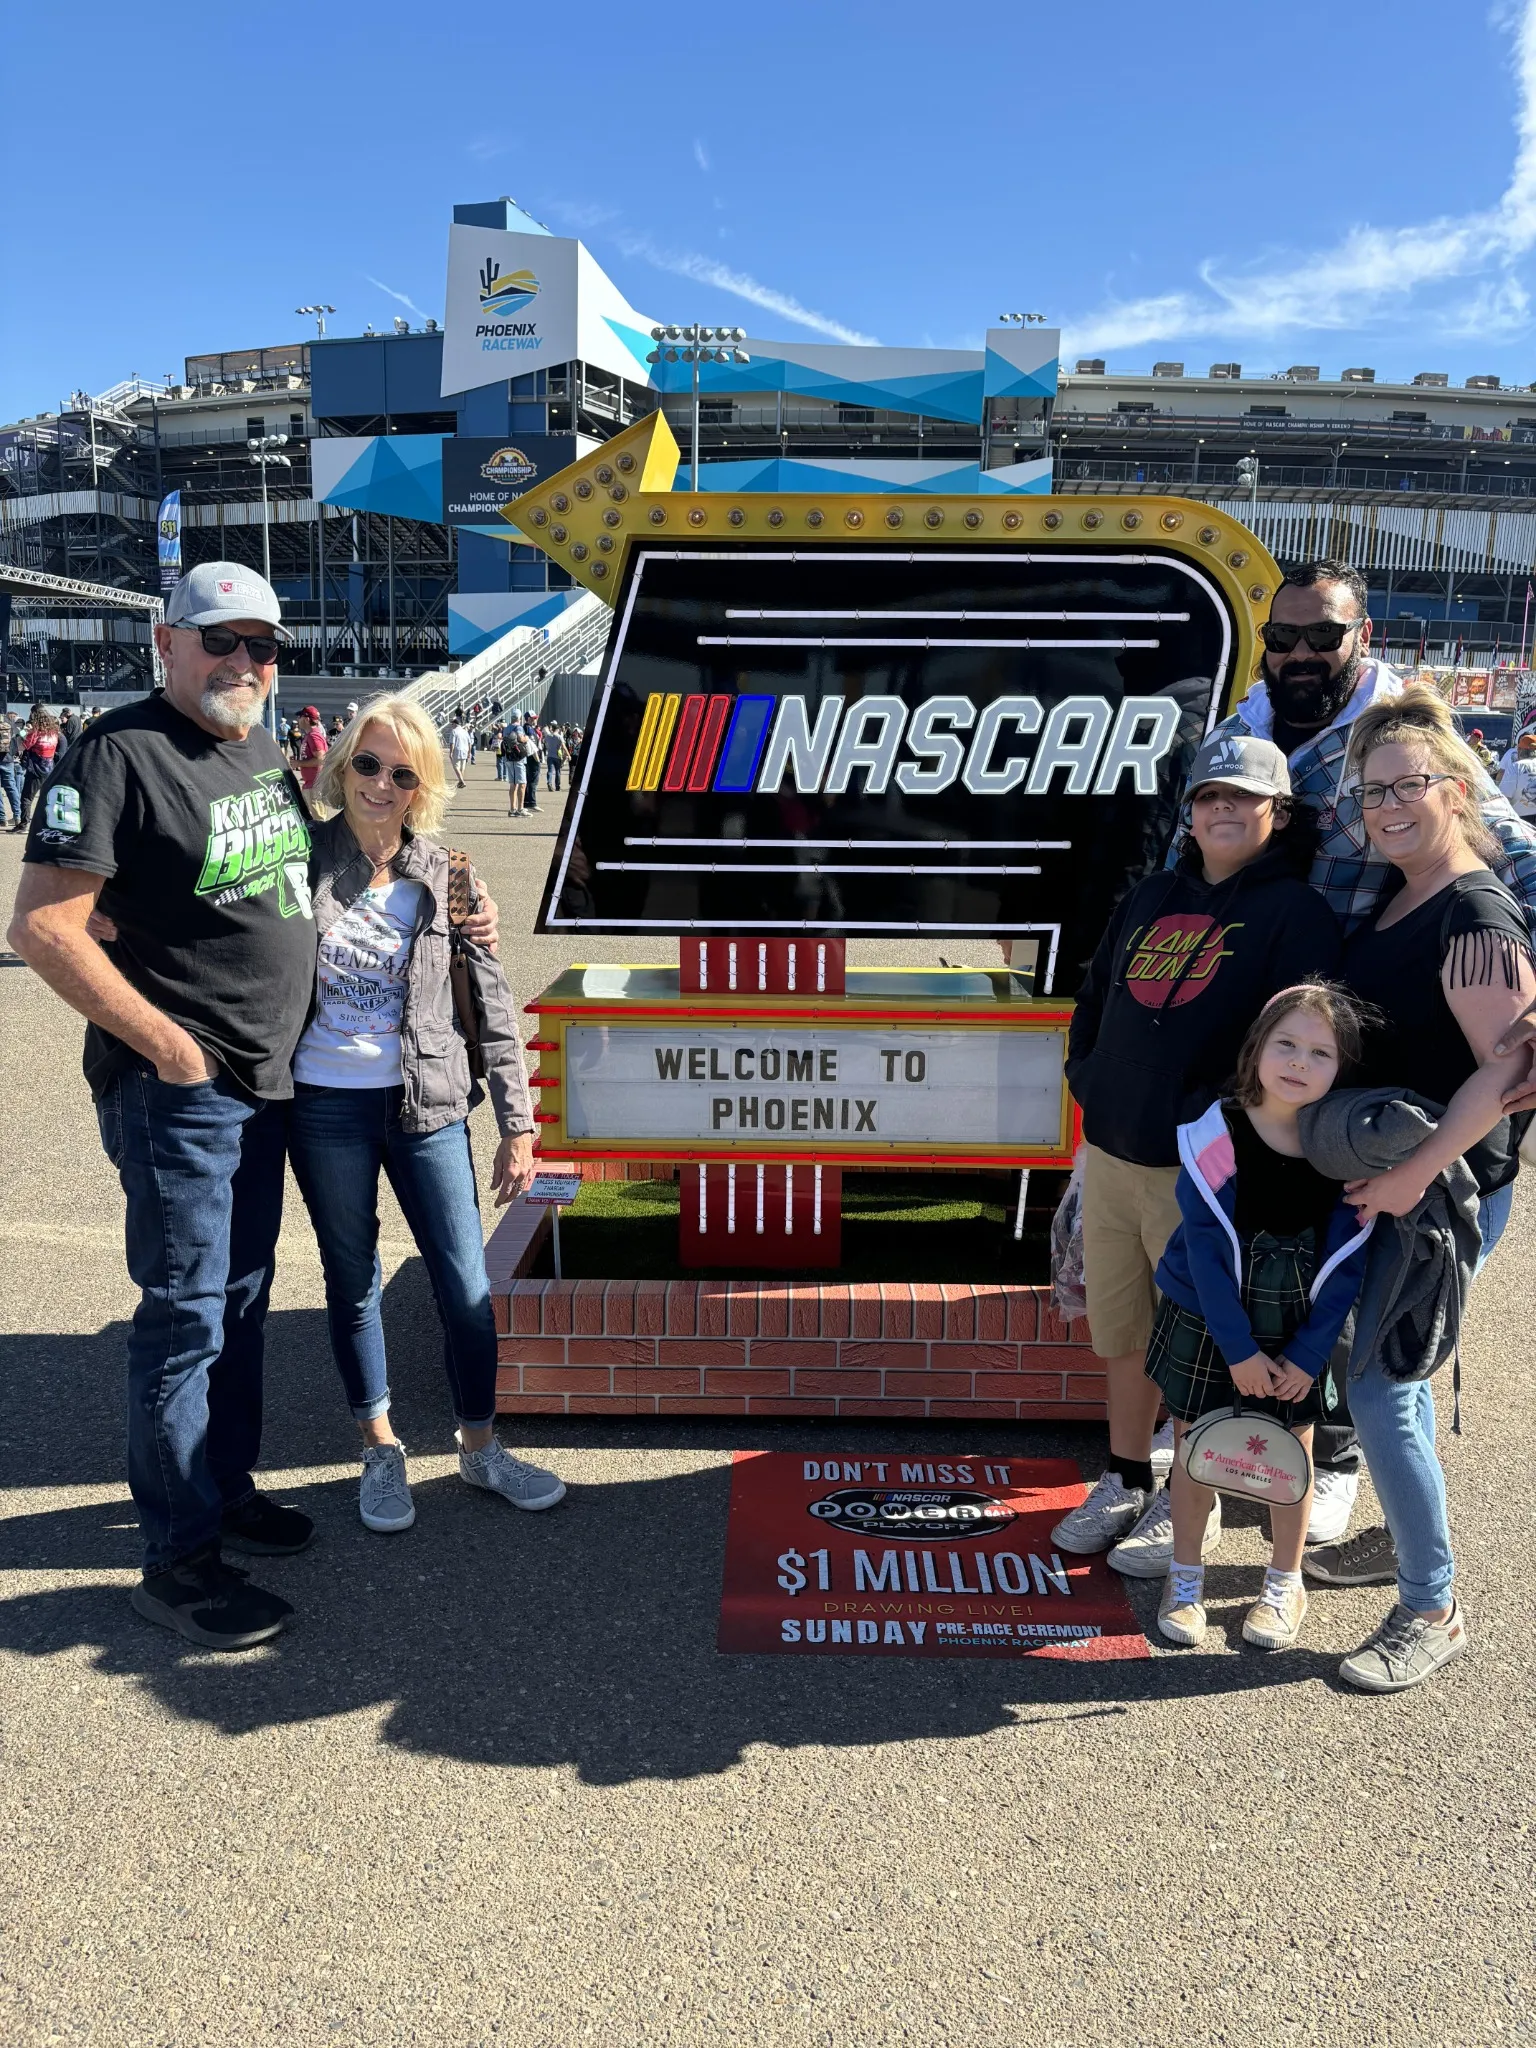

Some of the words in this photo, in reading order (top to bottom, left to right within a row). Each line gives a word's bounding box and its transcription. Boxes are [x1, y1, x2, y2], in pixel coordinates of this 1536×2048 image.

[475, 323, 537, 337] PHOENIX
[481, 337, 543, 351] RACEWAY
[486, 466, 532, 475] CHAMPIONSHIP
[469, 492, 495, 501] HOME
[497, 492, 510, 501] OF
[161, 521, 177, 533] 811
[757, 694, 1182, 794] NASCAR
[46, 785, 81, 834] 8
[212, 791, 270, 835] KYLE
[1125, 951, 1234, 980] DUNES
[327, 984, 400, 999] HARLEY-DAVIN
[1144, 997, 1185, 1007] CALIFNIA
[339, 1013, 371, 1023] SINCE
[654, 1047, 837, 1082] WELCOME
[880, 1049, 926, 1083] TO
[712, 1096, 877, 1132] PHOENIX
[803, 1460, 889, 1483] DON'T
[901, 1462, 976, 1485] MISS
[984, 1464, 1012, 1485] IT
[1215, 1453, 1257, 1472] American
[1257, 1464, 1274, 1476] Girl
[1274, 1467, 1297, 1482] Place
[1225, 1467, 1239, 1475] LOS
[1240, 1471, 1272, 1484] ANGELES
[892, 1493, 951, 1503] NASCAR
[862, 1521, 973, 1530] PLAYOFF
[777, 1548, 830, 1596] $1
[853, 1549, 1072, 1595] MILLION
[824, 1602, 955, 1616] DRAWING
[967, 1604, 1034, 1617] LIVE!
[781, 1618, 928, 1645] SUNDAY
[935, 1622, 1014, 1636] PRE-RACE
[1017, 1624, 1102, 1637] CEREMONY
[938, 1636, 1008, 1647] PHOENIX
[1012, 1638, 1090, 1648] RACEWAY
